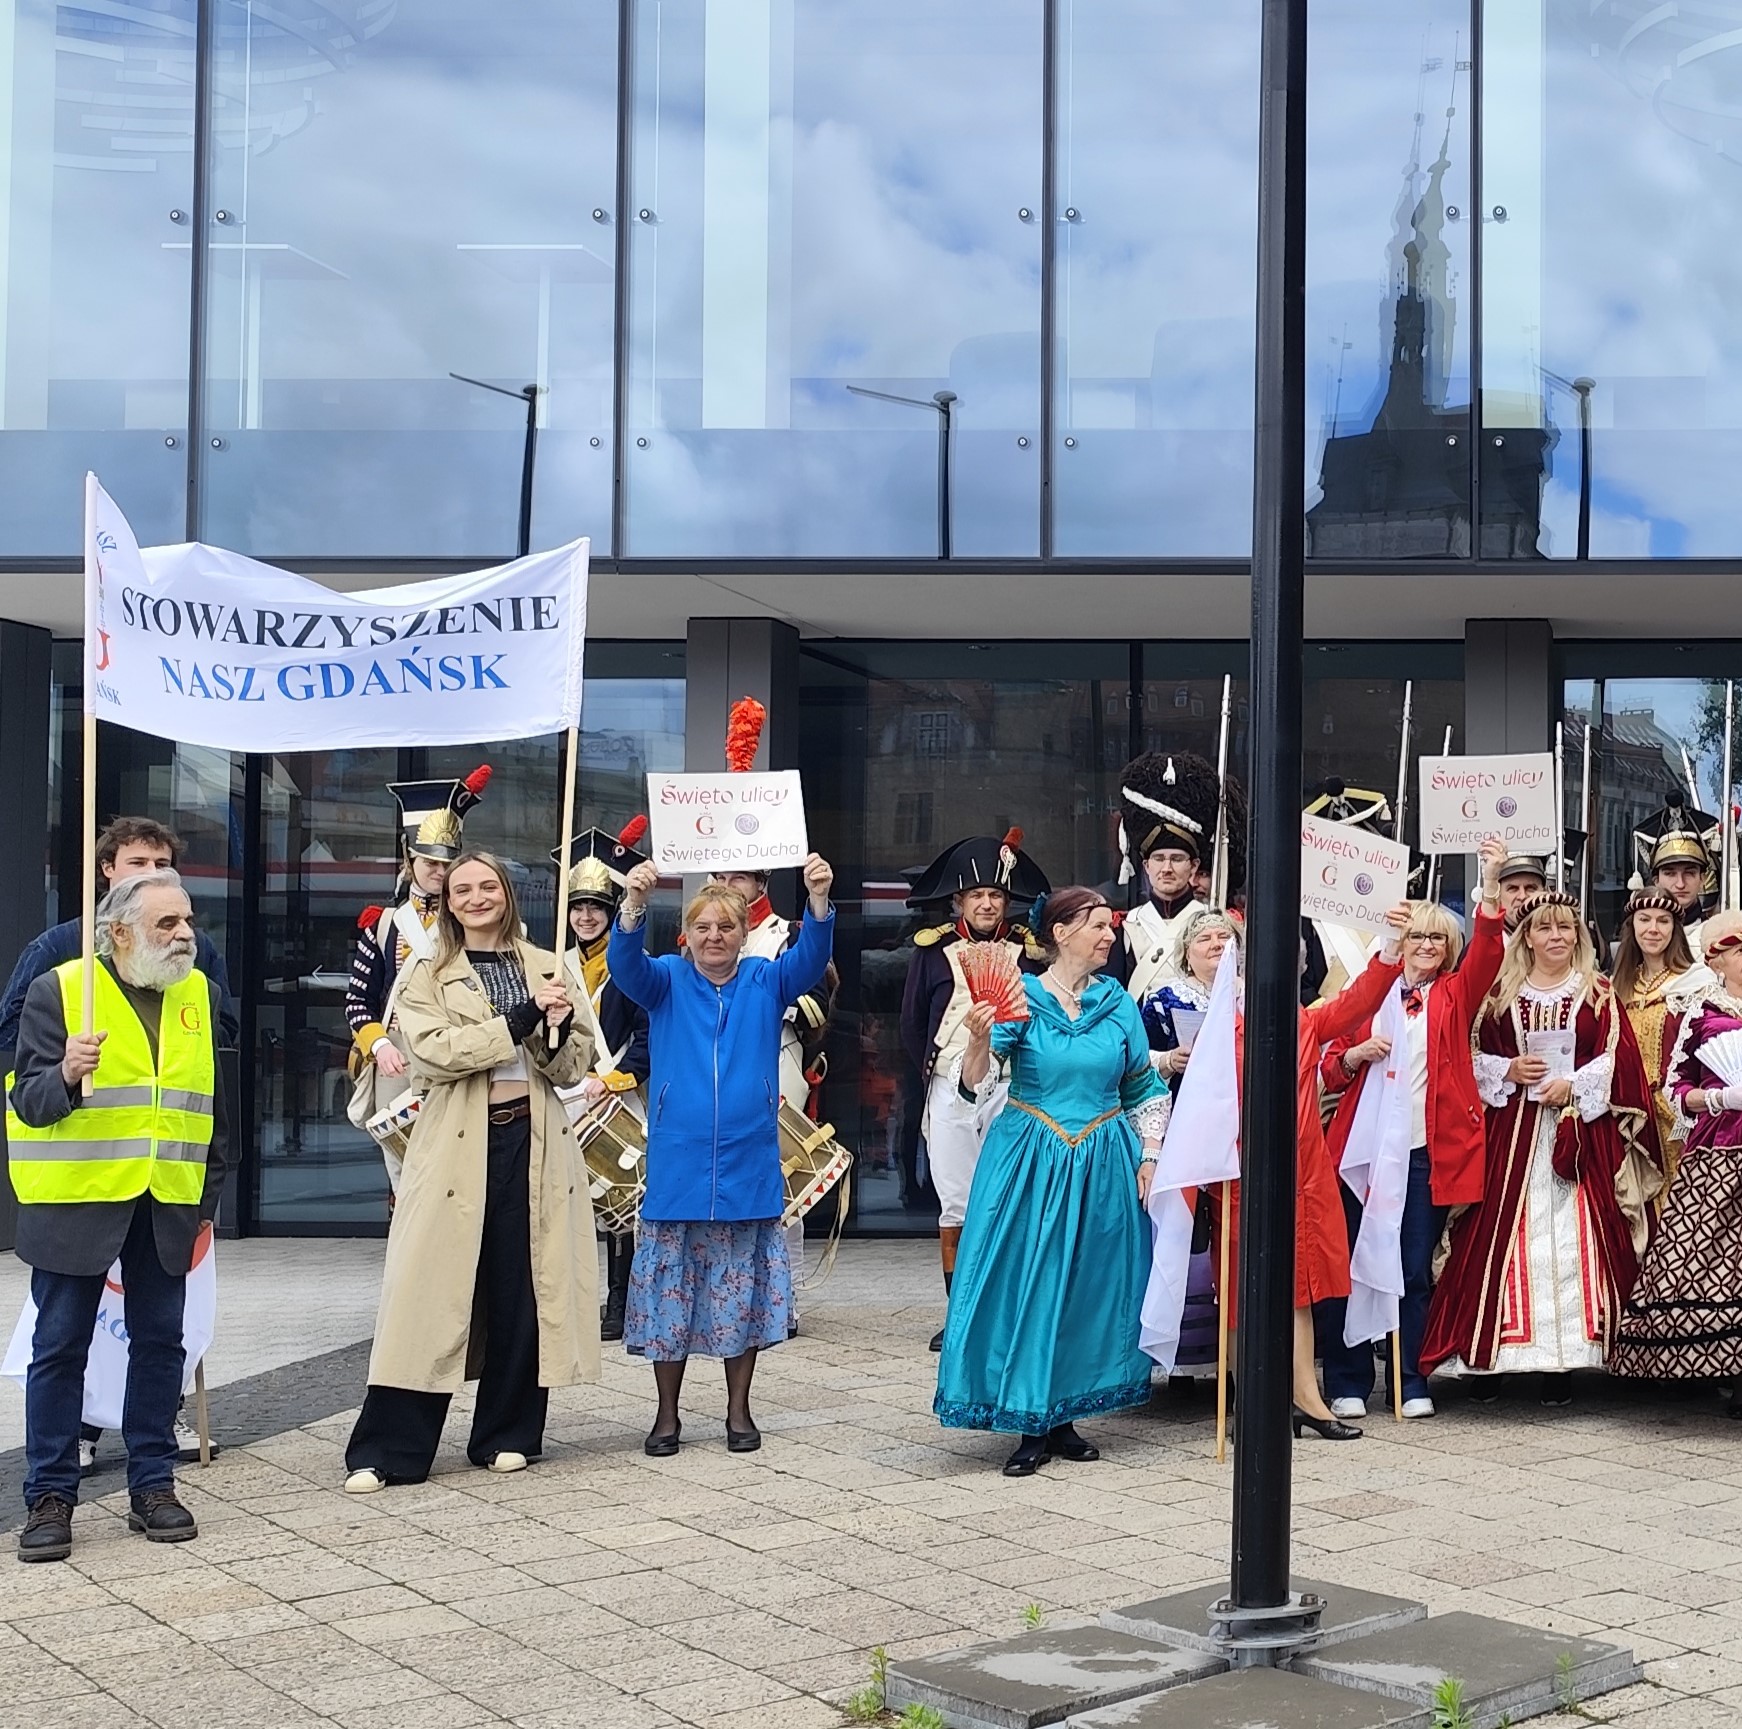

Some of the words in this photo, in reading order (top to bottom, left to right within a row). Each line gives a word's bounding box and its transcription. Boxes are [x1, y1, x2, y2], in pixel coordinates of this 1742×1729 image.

[122, 587, 560, 649] STOWARZYSZENIE
[158, 656, 265, 701] NASZ
[277, 646, 511, 701] GDAŃSK
[1431, 765, 1496, 793] Święto
[1502, 769, 1543, 789] ulicy
[660, 780, 733, 810] Święto
[741, 786, 789, 806] ulicy
[1302, 822, 1360, 860] Święto
[1365, 850, 1401, 874] ulicy
[1504, 825, 1550, 840] Ducha
[661, 840, 742, 864] Świętego
[747, 842, 800, 858] Ducha
[1301, 892, 1353, 917] więtego
[1356, 904, 1388, 925] Duch
